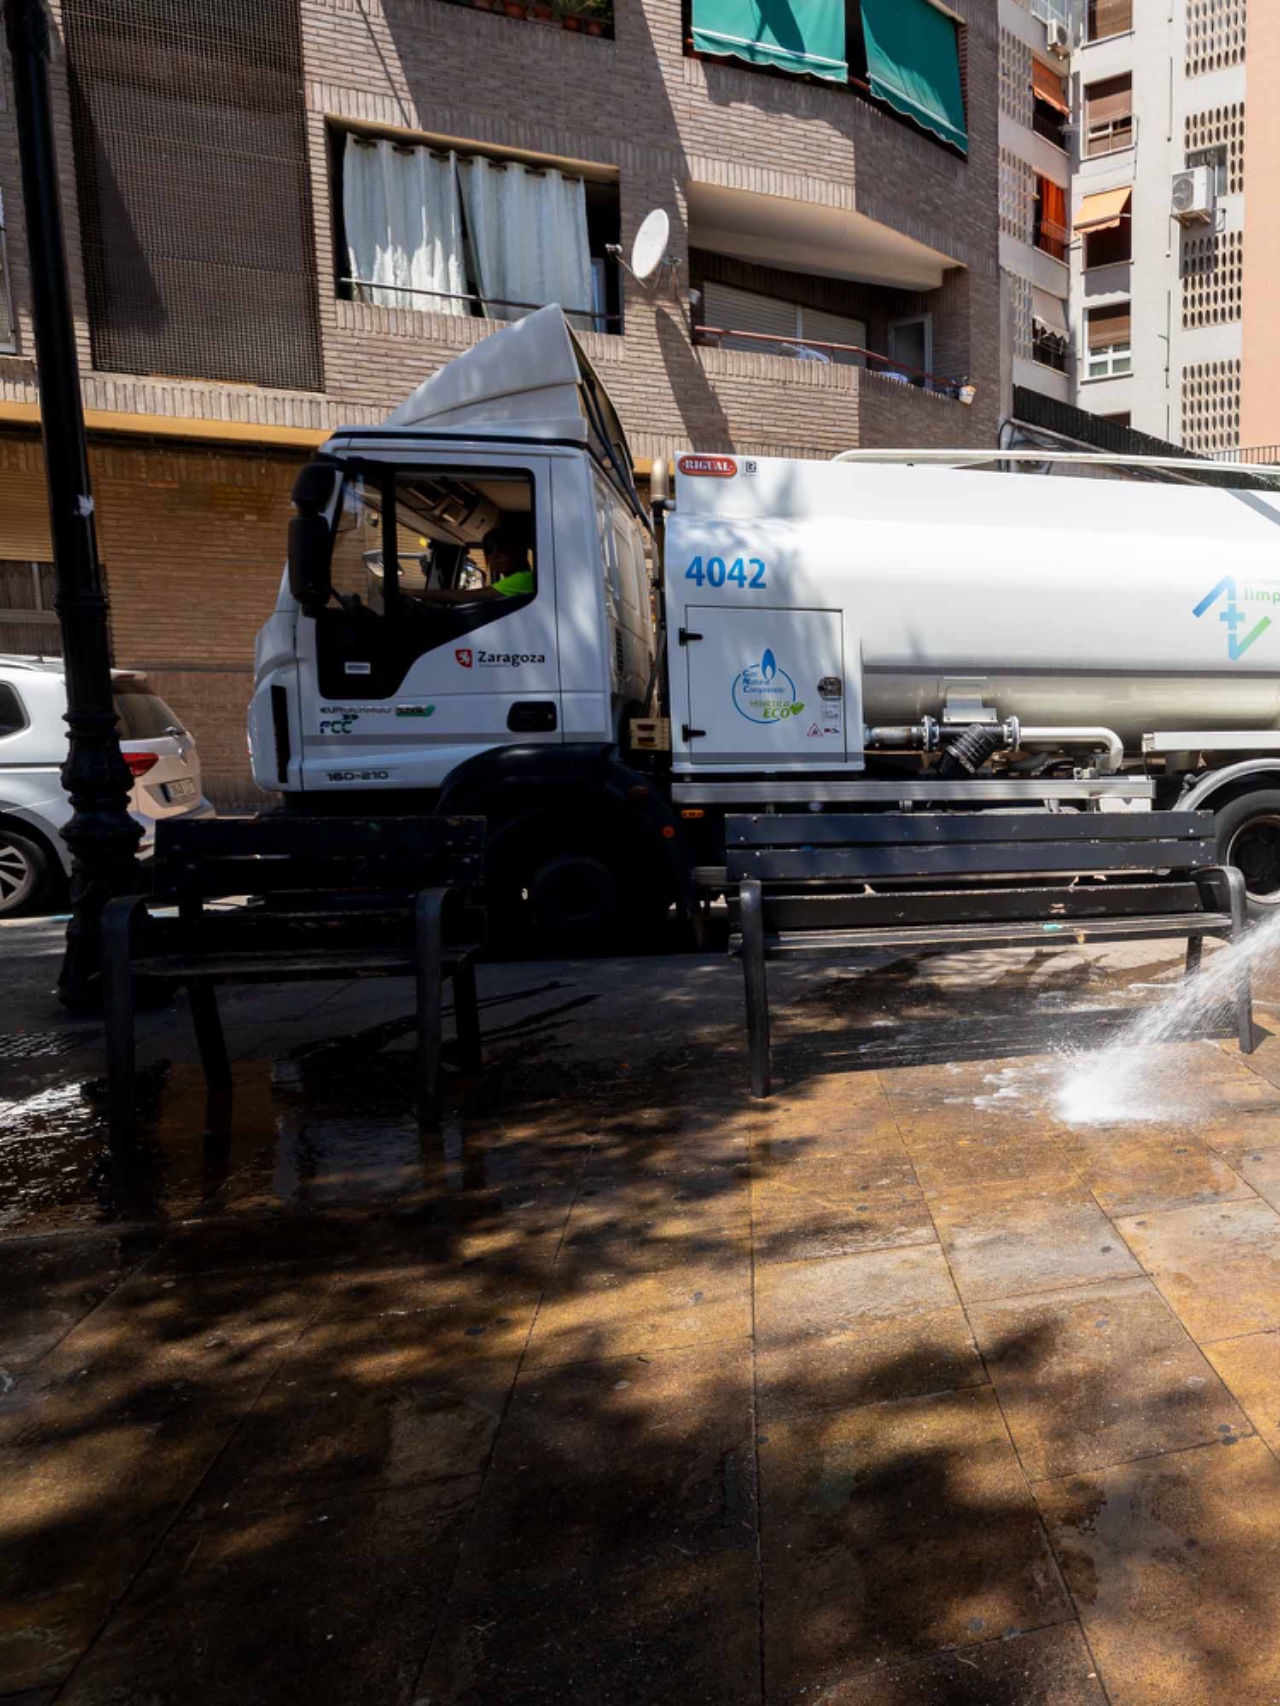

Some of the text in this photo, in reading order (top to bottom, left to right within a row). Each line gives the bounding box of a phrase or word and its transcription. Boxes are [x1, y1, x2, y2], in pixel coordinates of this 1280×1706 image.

[685, 459, 731, 472] RIGUAL
[684, 555, 767, 589] 4042
[477, 651, 546, 667] Zaragoza
[763, 707, 790, 719] ECO
[319, 721, 353, 734] FCC
